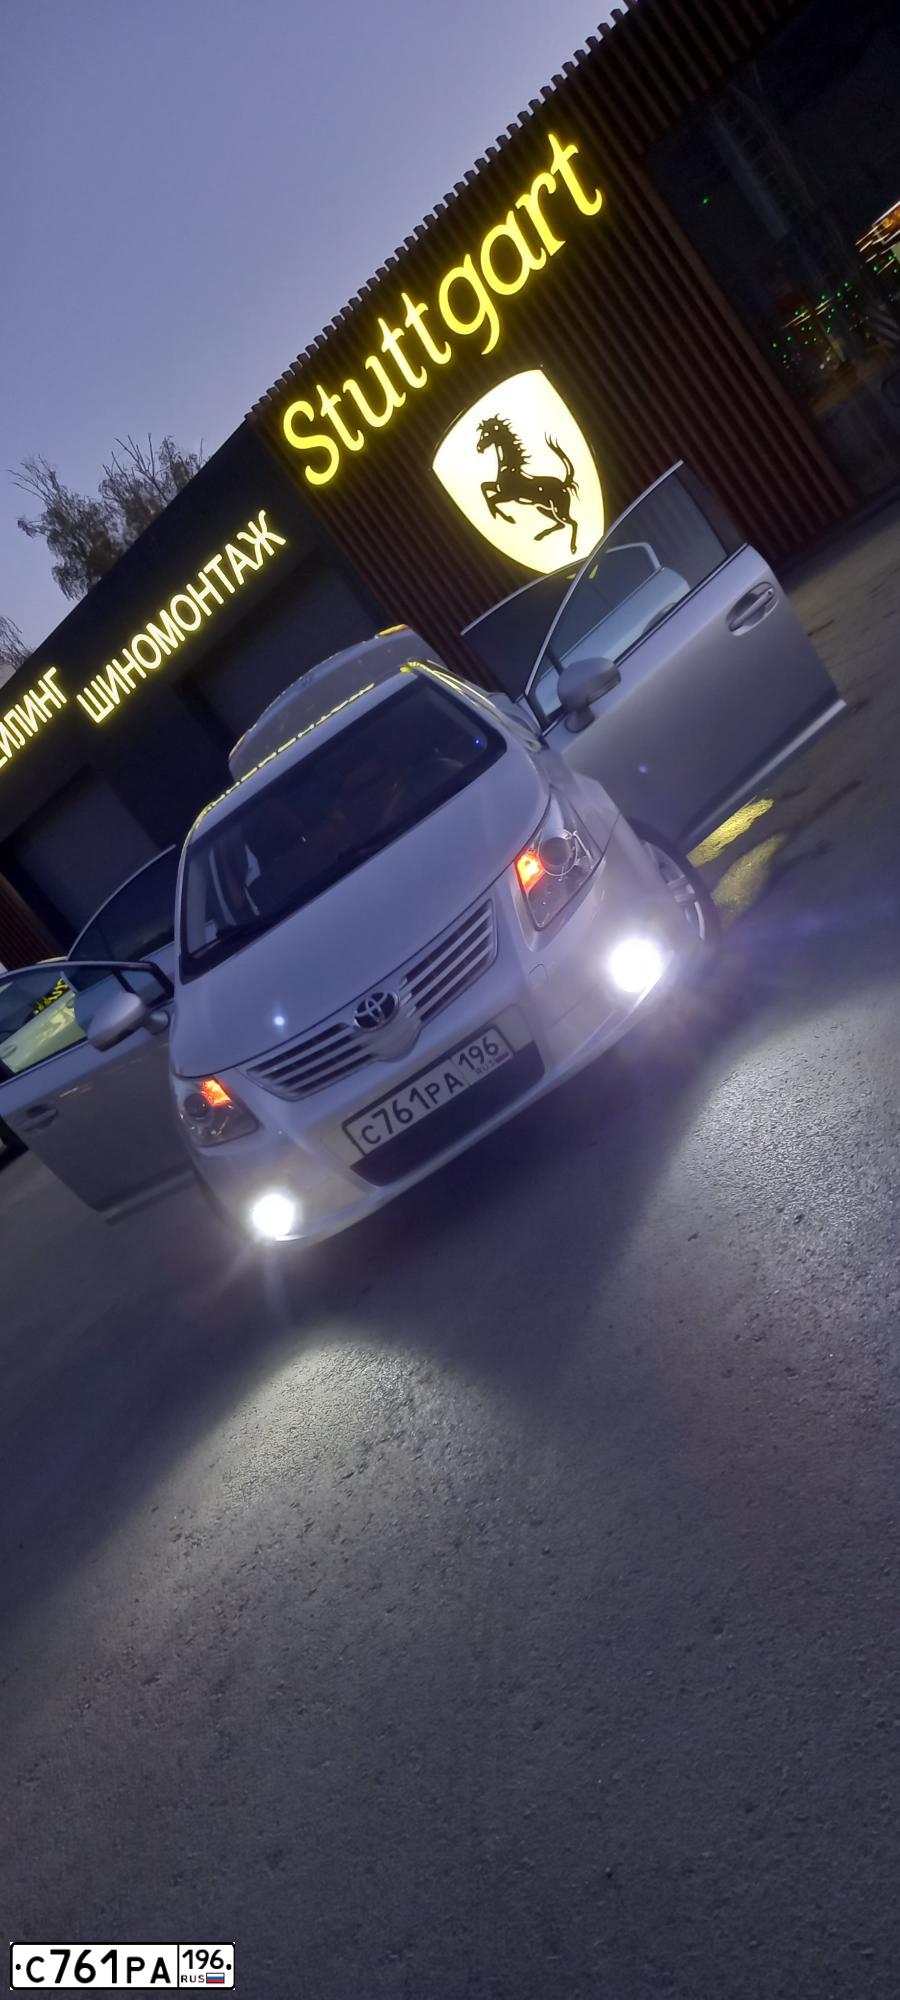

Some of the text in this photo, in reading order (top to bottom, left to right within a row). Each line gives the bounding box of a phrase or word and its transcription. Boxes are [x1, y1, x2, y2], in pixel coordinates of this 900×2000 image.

[283, 133, 603, 486] Stuttgart
[75, 509, 287, 724] ШИНОМОНТАЖ
[459, 1036, 499, 1070] 196
